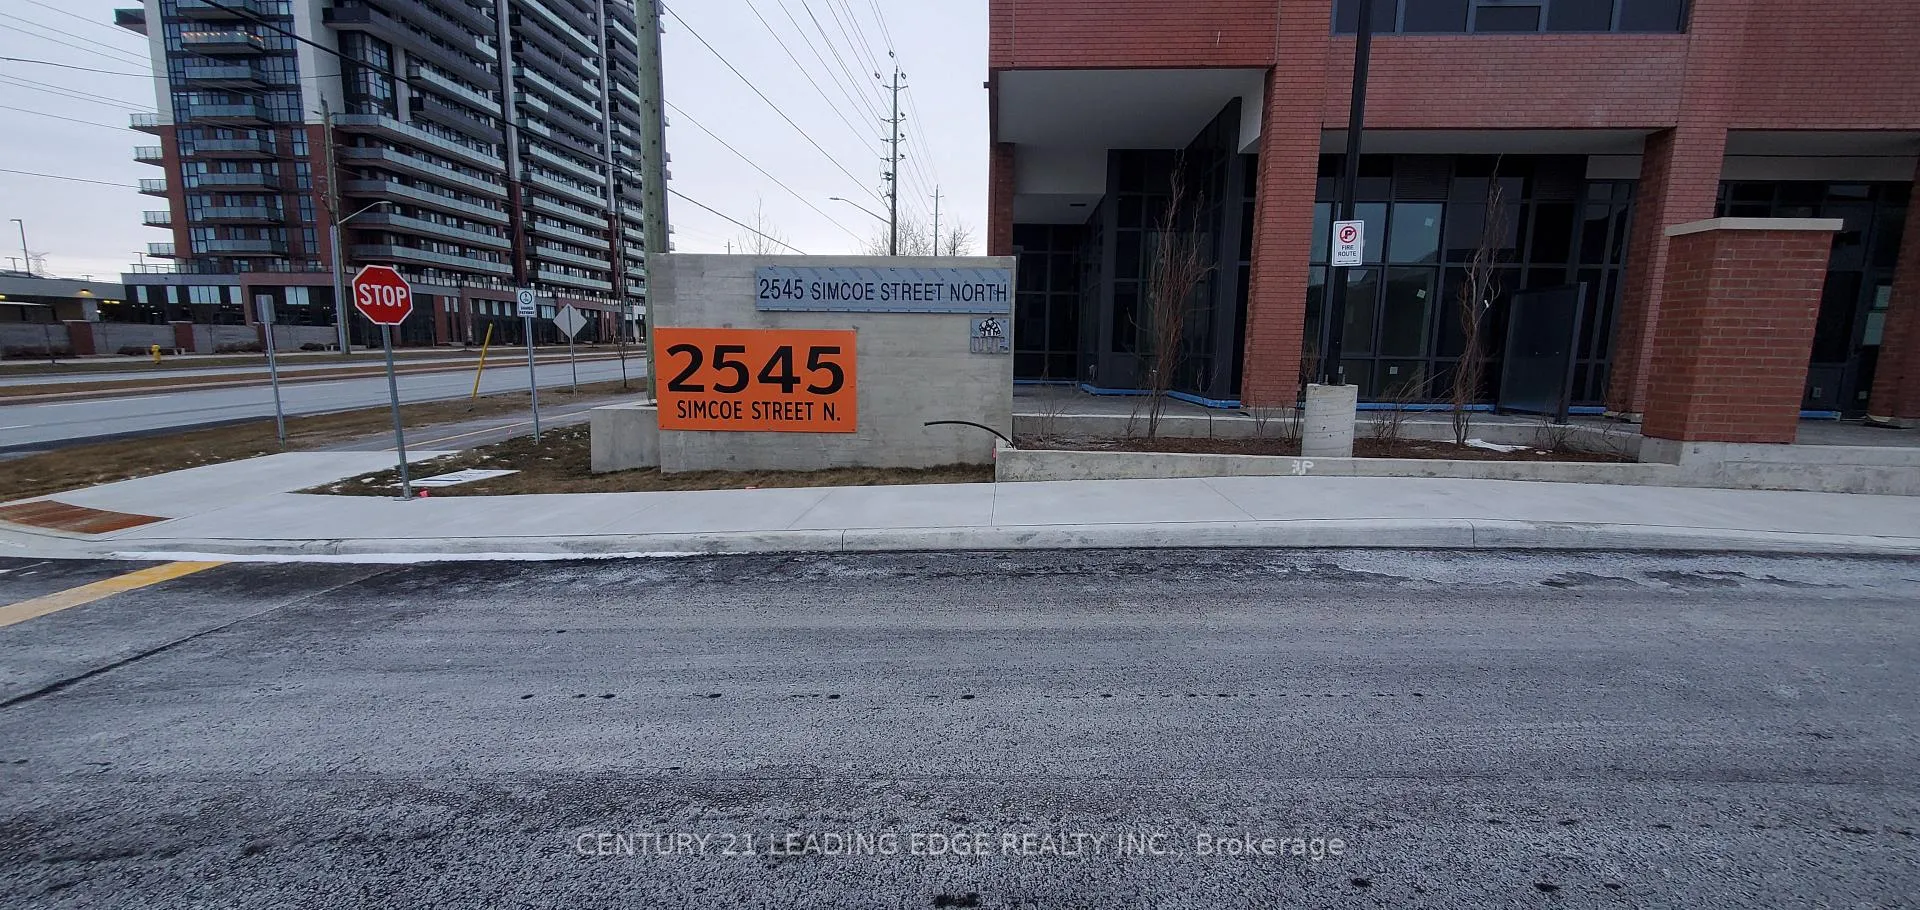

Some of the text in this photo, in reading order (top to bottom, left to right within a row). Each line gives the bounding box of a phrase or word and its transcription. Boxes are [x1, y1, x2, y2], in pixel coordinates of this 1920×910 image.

[359, 283, 407, 307] STOP
[759, 278, 1007, 302] 2545 SIMCOE STREET NORTH
[666, 343, 845, 395] 2545
[677, 399, 841, 421] SIMCOE STREET N.
